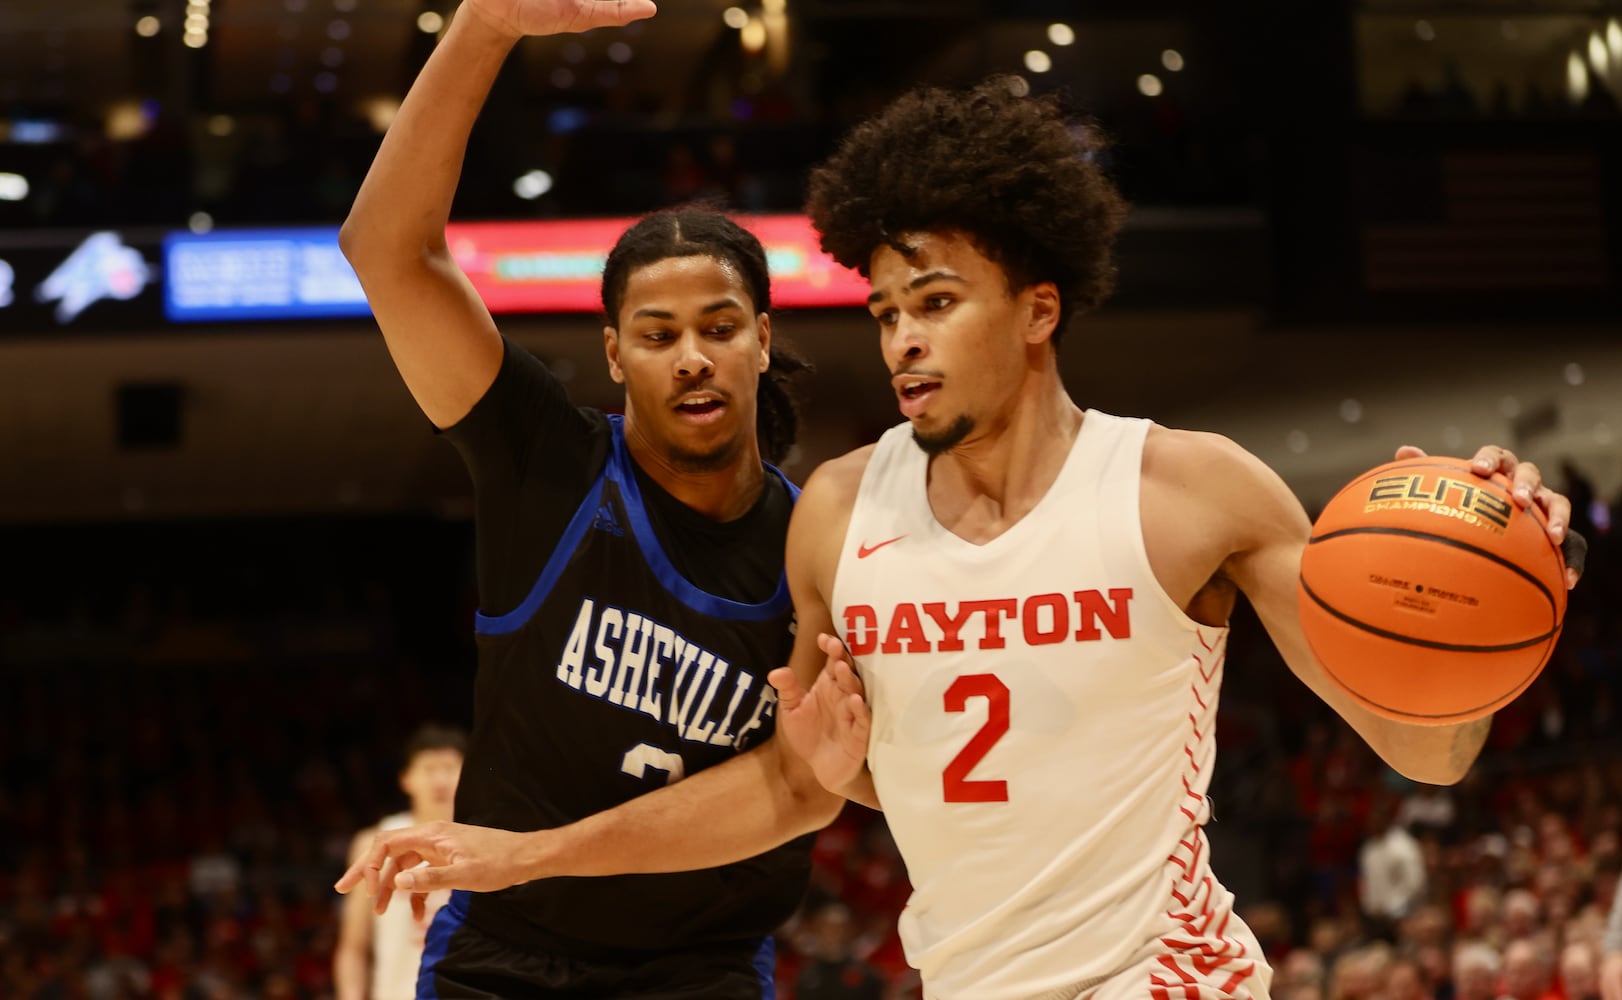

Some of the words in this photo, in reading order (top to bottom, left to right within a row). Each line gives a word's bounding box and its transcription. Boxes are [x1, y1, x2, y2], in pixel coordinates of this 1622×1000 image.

[1368, 474, 1513, 529] ELITE
[842, 588, 1134, 656] DAYTON
[555, 598, 778, 751] ASHEVILLE
[942, 673, 1011, 803] 2
